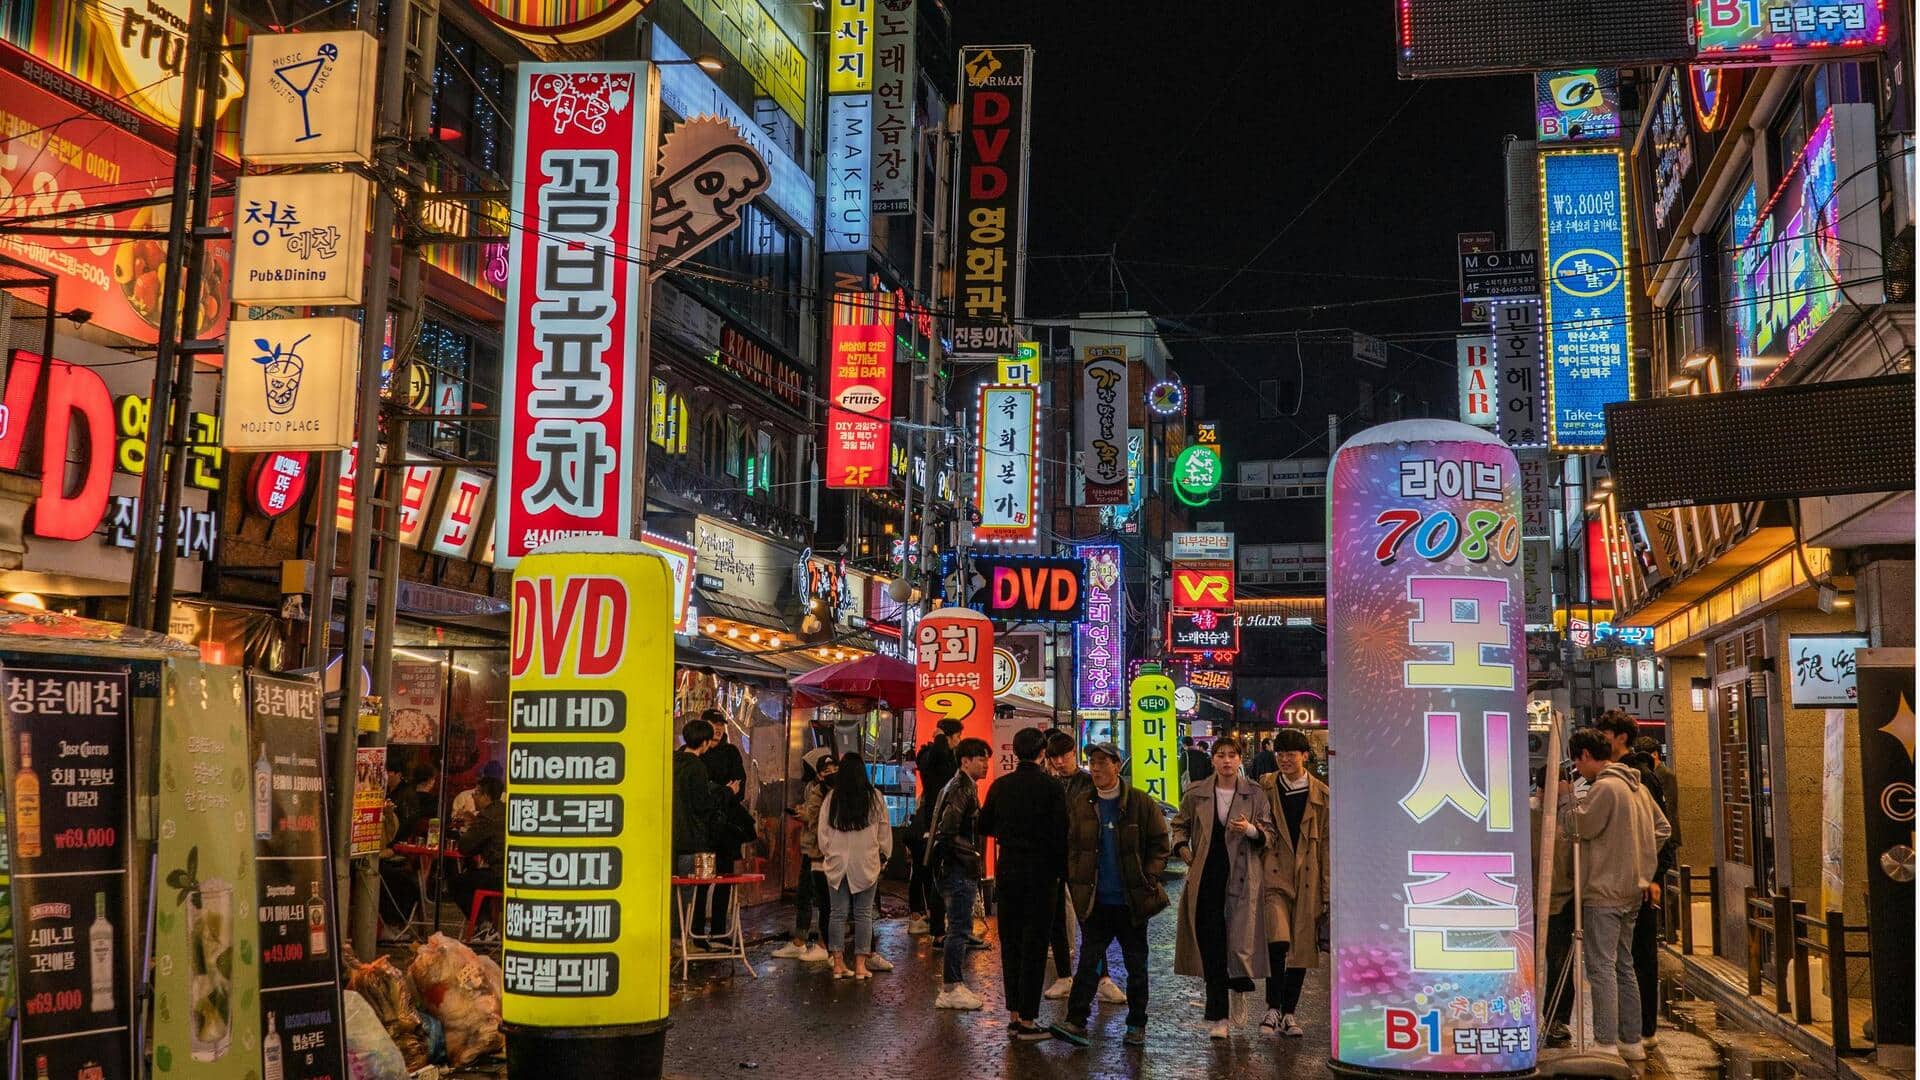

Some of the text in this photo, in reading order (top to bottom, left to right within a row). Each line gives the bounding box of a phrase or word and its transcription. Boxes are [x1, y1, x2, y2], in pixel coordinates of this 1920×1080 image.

[1709, 0, 1762, 29] B1
[1769, 4, 1866, 32] 단란주점
[272, 52, 303, 67] MUSIC
[269, 77, 296, 104] MOJITO
[312, 64, 334, 94] PLACE
[968, 75, 1024, 87] STARMAX
[876, 15, 908, 180] 노래연습장
[1542, 116, 1569, 136] B1
[1571, 110, 1615, 123] Lina
[970, 91, 1011, 201] DVD
[86, 152, 120, 187] 이야기
[1553, 190, 1615, 218] ₩3,800원
[244, 200, 301, 246] 청춘
[287, 225, 341, 260] 예찬
[249, 268, 327, 282] Pub&Dining
[528, 155, 612, 510] 꼼보포차
[954, 327, 1015, 349] 진동의자
[838, 366, 887, 378] 과일 BAR
[1467, 346, 1489, 414] BAR
[1569, 367, 1612, 379] 수입맥주
[240, 418, 321, 433] MOJITO PLACE
[835, 422, 852, 431] DIY
[1198, 430, 1217, 442] 24
[993, 395, 1020, 518] 육회본가
[844, 465, 873, 486] 2F
[1399, 459, 1503, 502] 라이브
[1374, 508, 1522, 564] 7080
[992, 566, 1079, 612] DVD
[1178, 575, 1230, 602] VR
[511, 576, 629, 676] DVD
[1088, 586, 1112, 690] 노래연습장
[1177, 630, 1231, 645] 노래연습장
[919, 624, 978, 672] 육회
[512, 697, 616, 728] Full HD
[1140, 699, 1167, 710] 넥타이
[510, 749, 617, 780] Cinema
[1143, 717, 1169, 802] 마사지
[1398, 575, 1519, 974] 포시즌
[51, 768, 77, 786] 호세
[509, 798, 614, 834] 대형스크린
[507, 852, 613, 886] 진동의자
[506, 902, 612, 940] 영화+팝콘+커피
[504, 955, 610, 993] 무료셀프바
[1383, 1007, 1442, 1056] B1
[1453, 1024, 1532, 1055] 단란주점
